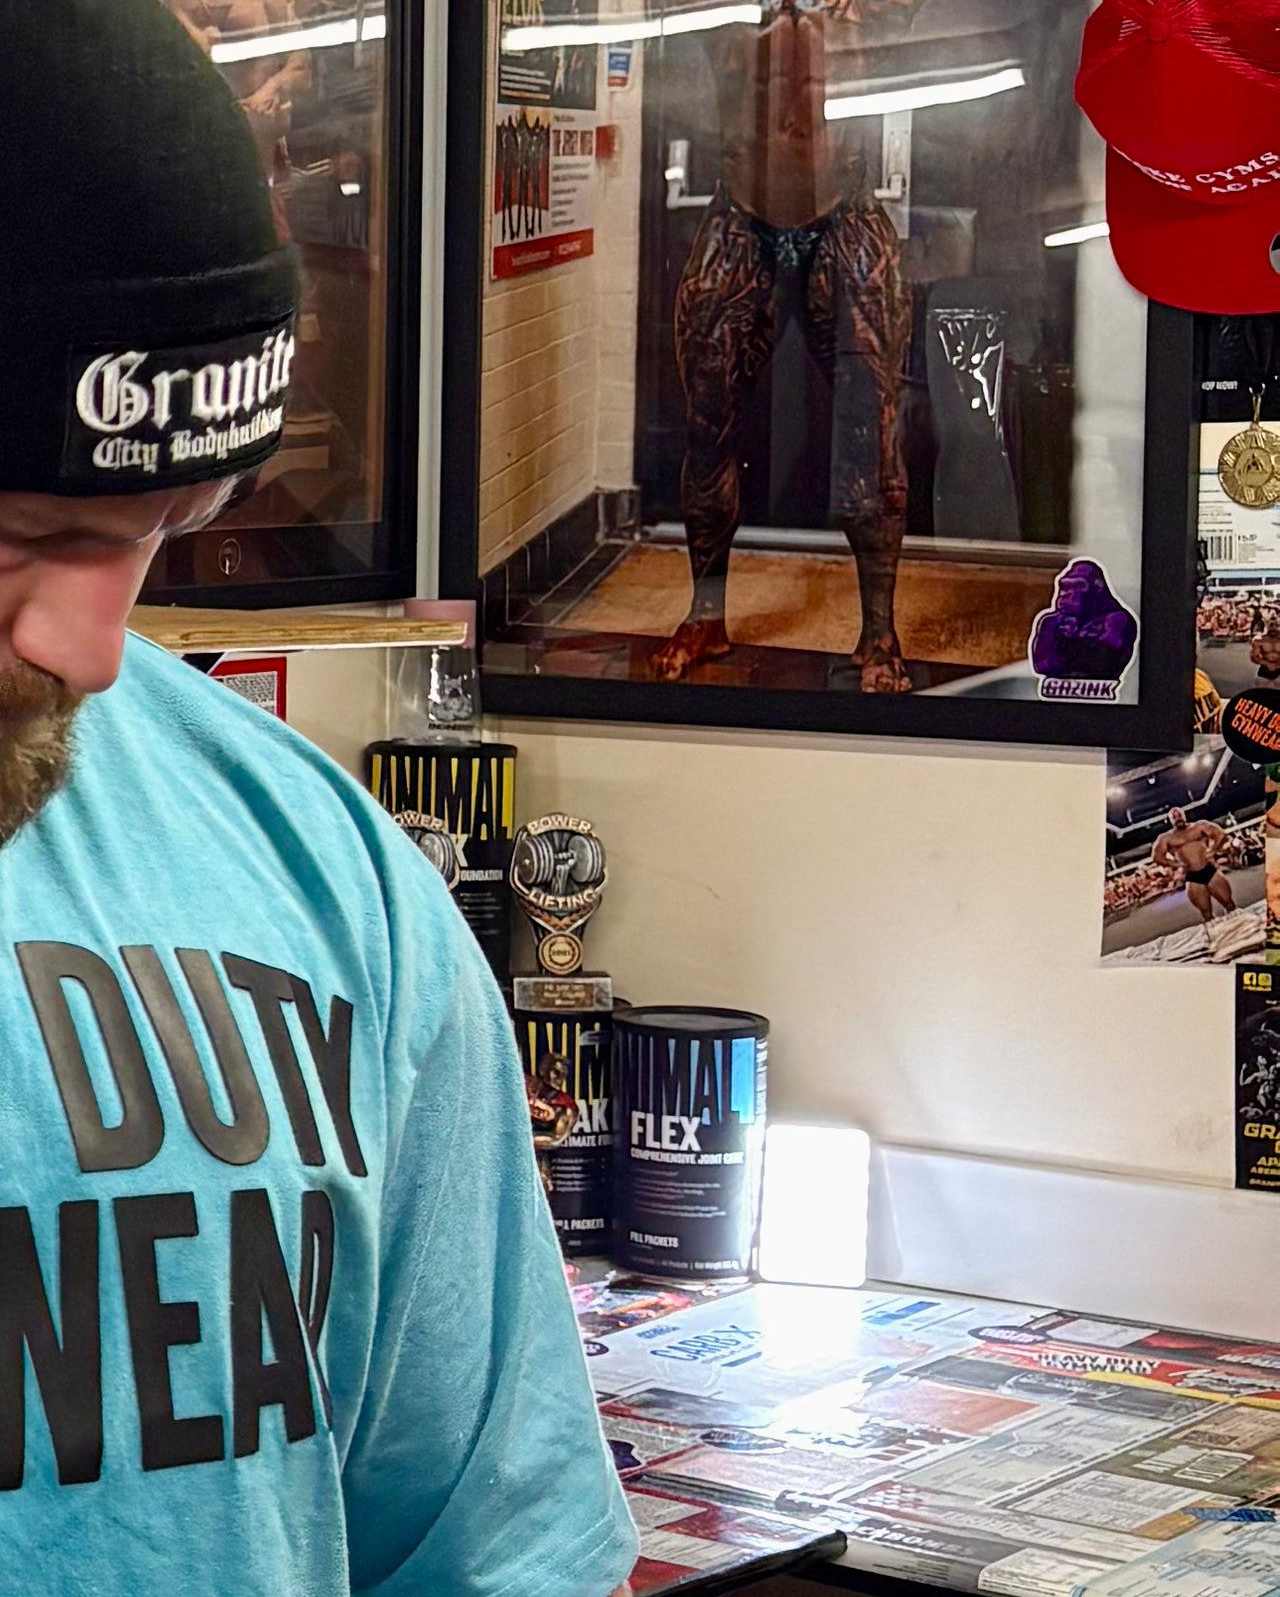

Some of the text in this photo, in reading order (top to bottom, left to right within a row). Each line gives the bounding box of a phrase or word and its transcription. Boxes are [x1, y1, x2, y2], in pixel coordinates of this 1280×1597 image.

[92, 436, 161, 474] City
[1235, 698, 1271, 725] HEAVY
[528, 813, 591, 835] POWER
[528, 890, 596, 908] LIFTING
[14, 940, 369, 1178] DUTY
[631, 1111, 701, 1152] FLEX
